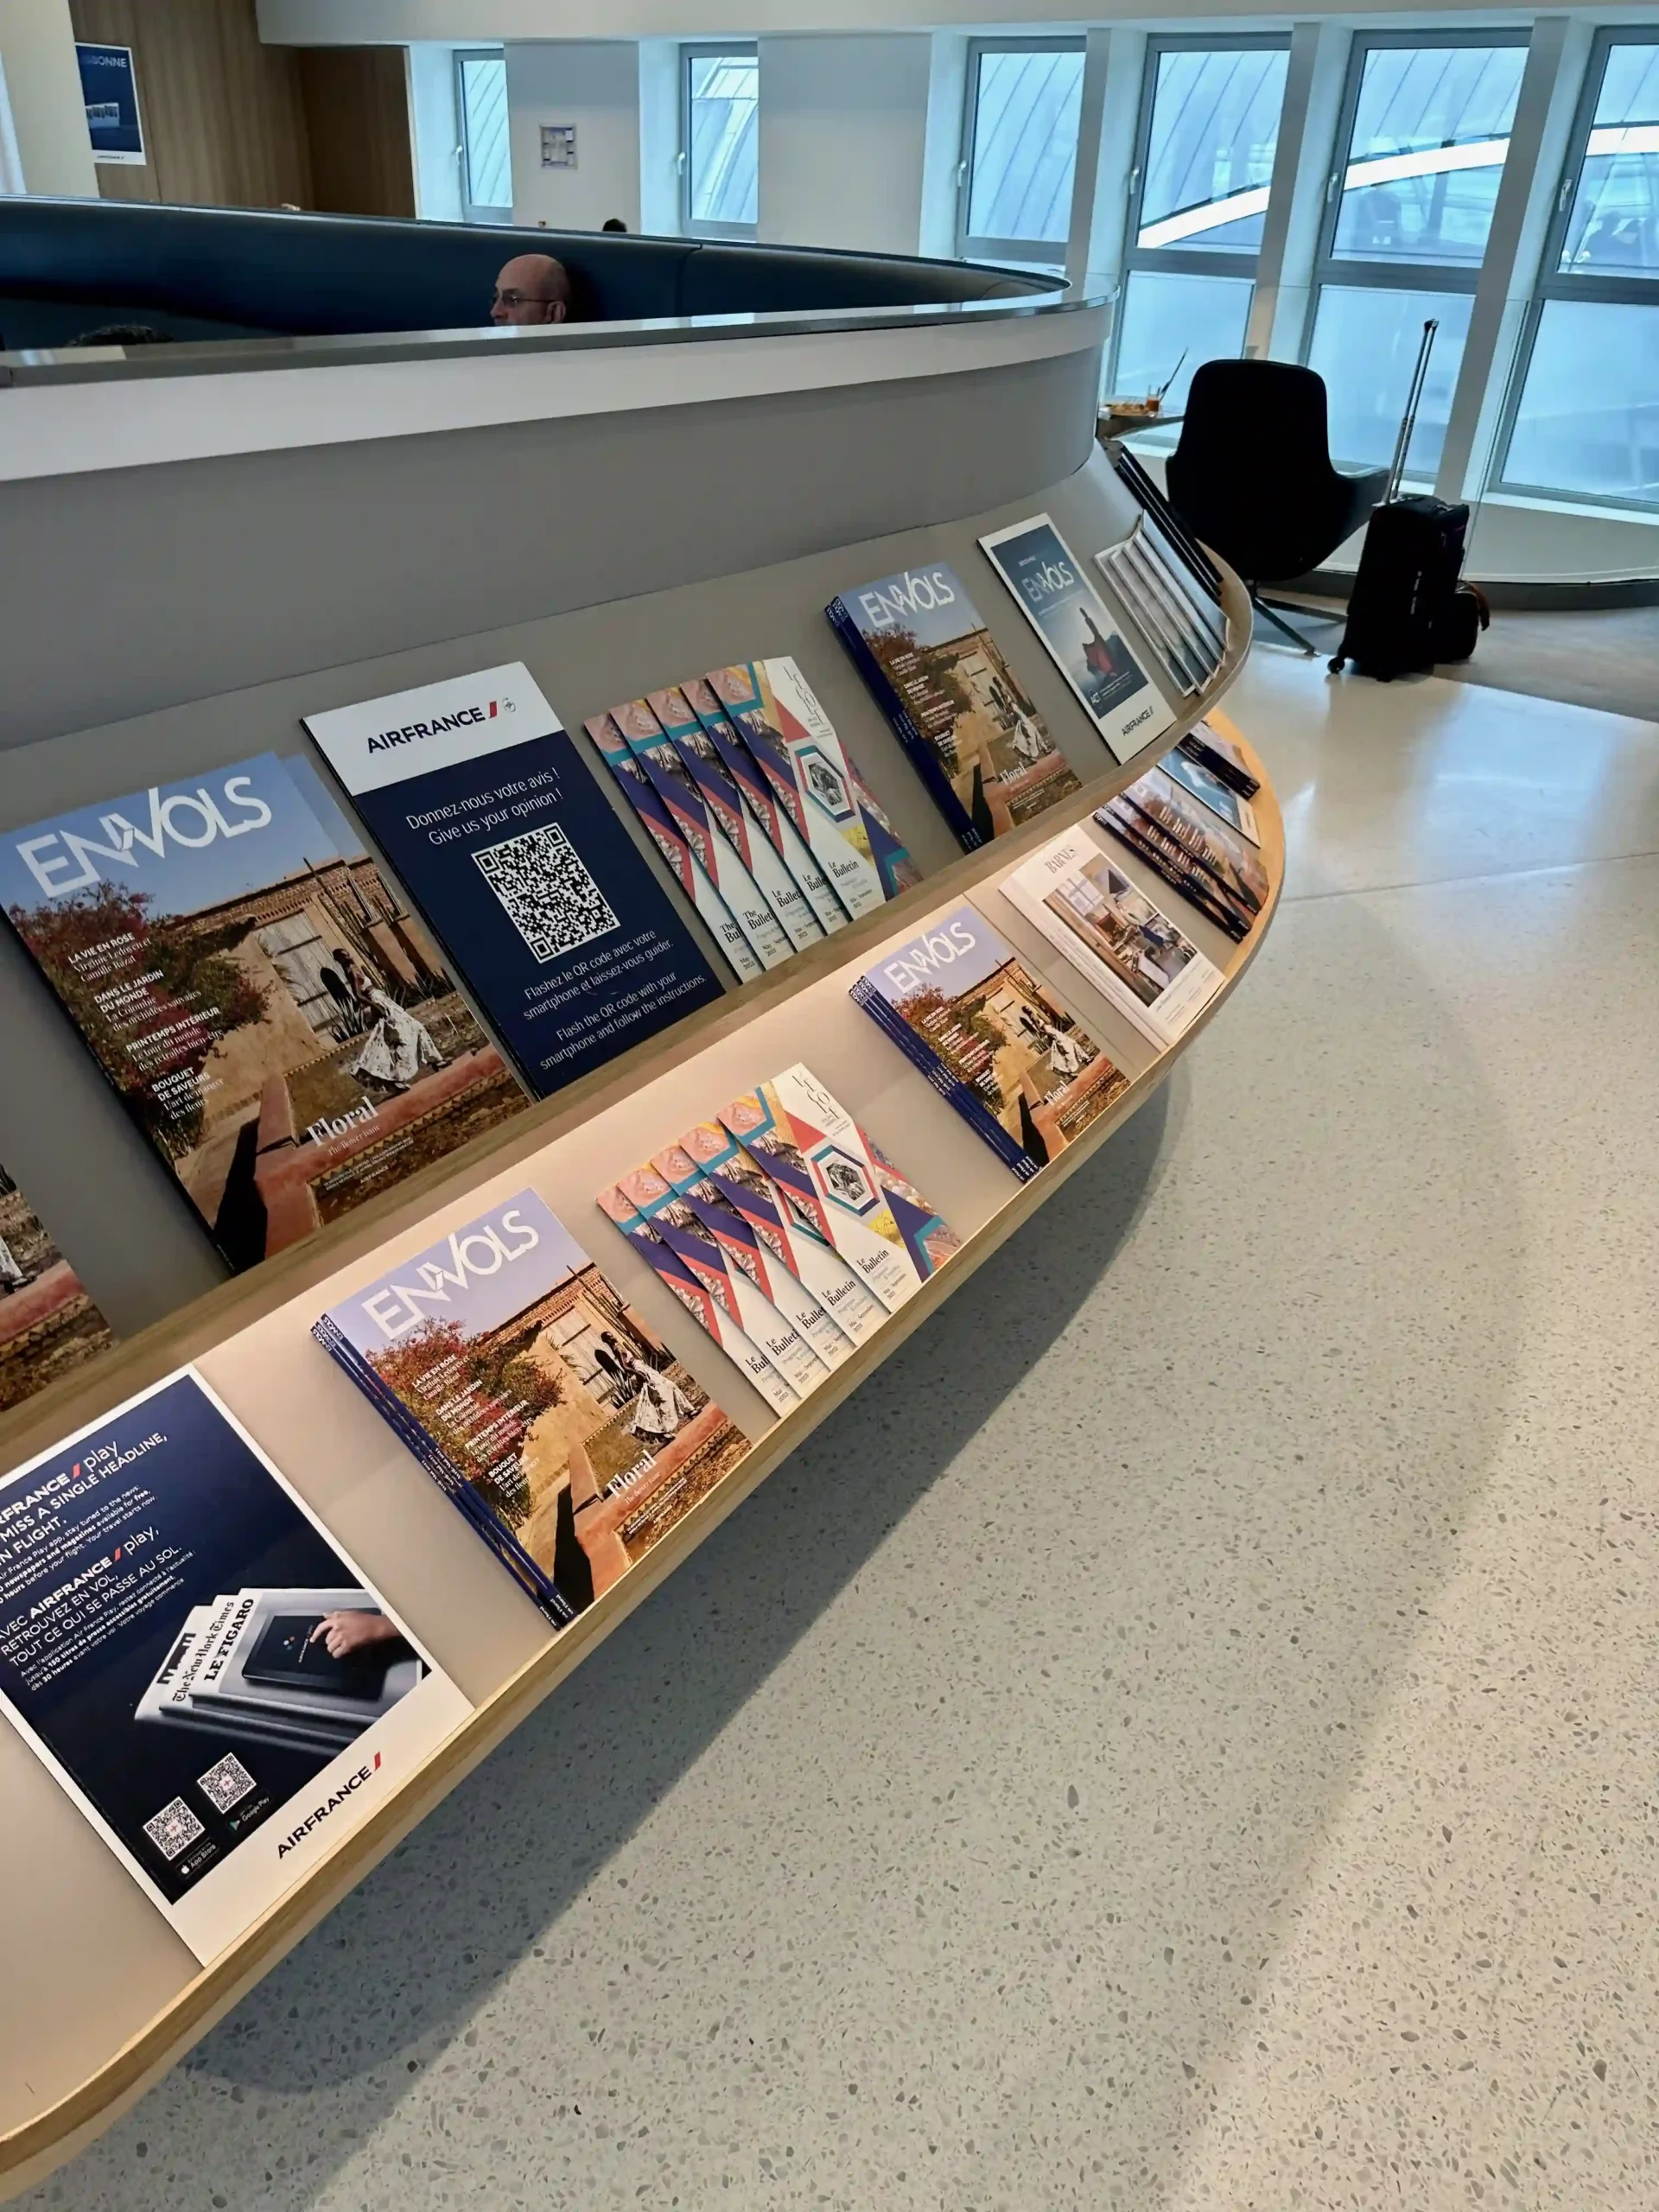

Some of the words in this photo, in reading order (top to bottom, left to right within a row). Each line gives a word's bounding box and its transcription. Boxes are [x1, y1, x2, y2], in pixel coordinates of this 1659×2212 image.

[366, 706, 486, 753] AIRFRANCE
[409, 790, 492, 829] Donnez-nous
[494, 779, 526, 799] votre
[527, 769, 552, 788] avis
[552, 766, 560, 779] !
[428, 823, 461, 846] Give
[462, 819, 479, 834] us
[480, 810, 510, 831] your
[512, 791, 556, 820] opinion
[555, 786, 563, 799] !
[802, 874, 811, 882] Le
[807, 876, 827, 891] Bulle
[832, 860, 859, 878] Bulletin
[772, 889, 781, 898] Le
[776, 891, 802, 907] Bullet
[720, 922, 736, 932] The
[742, 910, 757, 919] The
[68, 952, 81, 963] LA
[80, 946, 97, 958] VIE
[97, 941, 111, 951] EN
[110, 931, 134, 946] ROSE
[525, 973, 563, 1001] Flashez
[562, 968, 574, 982] le
[573, 961, 589, 977] QR
[588, 950, 612, 969] code
[612, 941, 633, 957] avec
[632, 930, 657, 946] votre
[525, 985, 580, 1023] smartphone
[580, 980, 591, 990] et
[591, 953, 644, 985] laissez-vous
[643, 938, 675, 961] guider.
[93, 988, 120, 1003] DANS
[120, 982, 133, 992] LE
[131, 969, 164, 988] JARDIN
[99, 1001, 116, 1013] DU
[114, 988, 149, 1007] MONDE
[541, 1033, 596, 1071] smartphone
[594, 1020, 614, 1039] and
[613, 1008, 641, 1028] follow
[640, 1000, 657, 1014] the
[655, 974, 707, 1004] instructions.
[556, 1020, 583, 1041] Flash
[583, 1011, 600, 1027] the
[600, 1002, 616, 1018] QR
[615, 991, 639, 1009] code
[637, 981, 658, 997] with
[657, 972, 680, 989] your
[126, 1026, 175, 1052] PRINTEMPS
[175, 1005, 219, 1031] INTÉRIEUR
[152, 1068, 195, 1092] BOUQUET
[157, 1090, 172, 1101] DE
[171, 1071, 210, 1095] SAVEURS
[307, 1095, 379, 1147] Floral
[856, 1258, 866, 1267] Le
[861, 1249, 889, 1274] Bulletin
[822, 1289, 831, 1298] Le
[827, 1280, 856, 1306] Bulletin
[796, 1312, 806, 1321] Le
[766, 1338, 776, 1348] Le
[771, 1328, 800, 1356] Bulleti
[411, 1377, 423, 1387] LA
[419, 1371, 433, 1382] VIE
[430, 1365, 442, 1375] EN
[440, 1355, 457, 1367] ROSE
[745, 1355, 756, 1366] Le
[751, 1354, 771, 1374] Bull
[435, 1401, 454, 1414] DANS
[459, 1380, 483, 1397] JARDIN
[441, 1411, 453, 1421] DU
[449, 1397, 474, 1414] MONDE
[463, 1422, 499, 1449] PRINTEMPS
[84, 1440, 119, 1472] play
[486, 1453, 518, 1477] BOUQUET
[0, 1515, 35, 1542] MISS
[38, 1507, 51, 1520] A
[49, 1474, 99, 1510] SINGLE
[99, 1432, 168, 1478] HEADLINE,
[493, 1474, 505, 1484] DE
[607, 1450, 658, 1500] Floral
[5, 1558, 46, 1589] newspapers
[47, 1548, 60, 1560] and
[60, 1525, 96, 1551] magazines
[97, 1506, 124, 1526] available
[124, 1498, 134, 1509] for
[134, 1490, 151, 1502] free,
[12, 1516, 67, 1554] FLIGHT.
[30, 1556, 113, 1619] AIRFRANCE
[124, 1526, 159, 1555] play,
[1, 1602, 72, 1656] RETROUVEZ
[71, 1590, 90, 1606] EN
[89, 1573, 119, 1592] VOL,
[10, 1640, 43, 1667] TOUT
[44, 1627, 63, 1643] CE
[62, 1611, 86, 1630] QUI
[87, 1599, 103, 1614] SE
[102, 1573, 138, 1602] PASSE
[139, 1560, 156, 1578] AU
[156, 1545, 182, 1565] SOL.
[172, 1681, 191, 1701] The
[182, 1658, 203, 1681] New
[195, 1631, 219, 1658] York
[209, 1601, 234, 1631] Times
[204, 1660, 224, 1681] LE
[218, 1599, 254, 1656] FIGARO
[275, 1765, 372, 1859] AIRFRANCE
